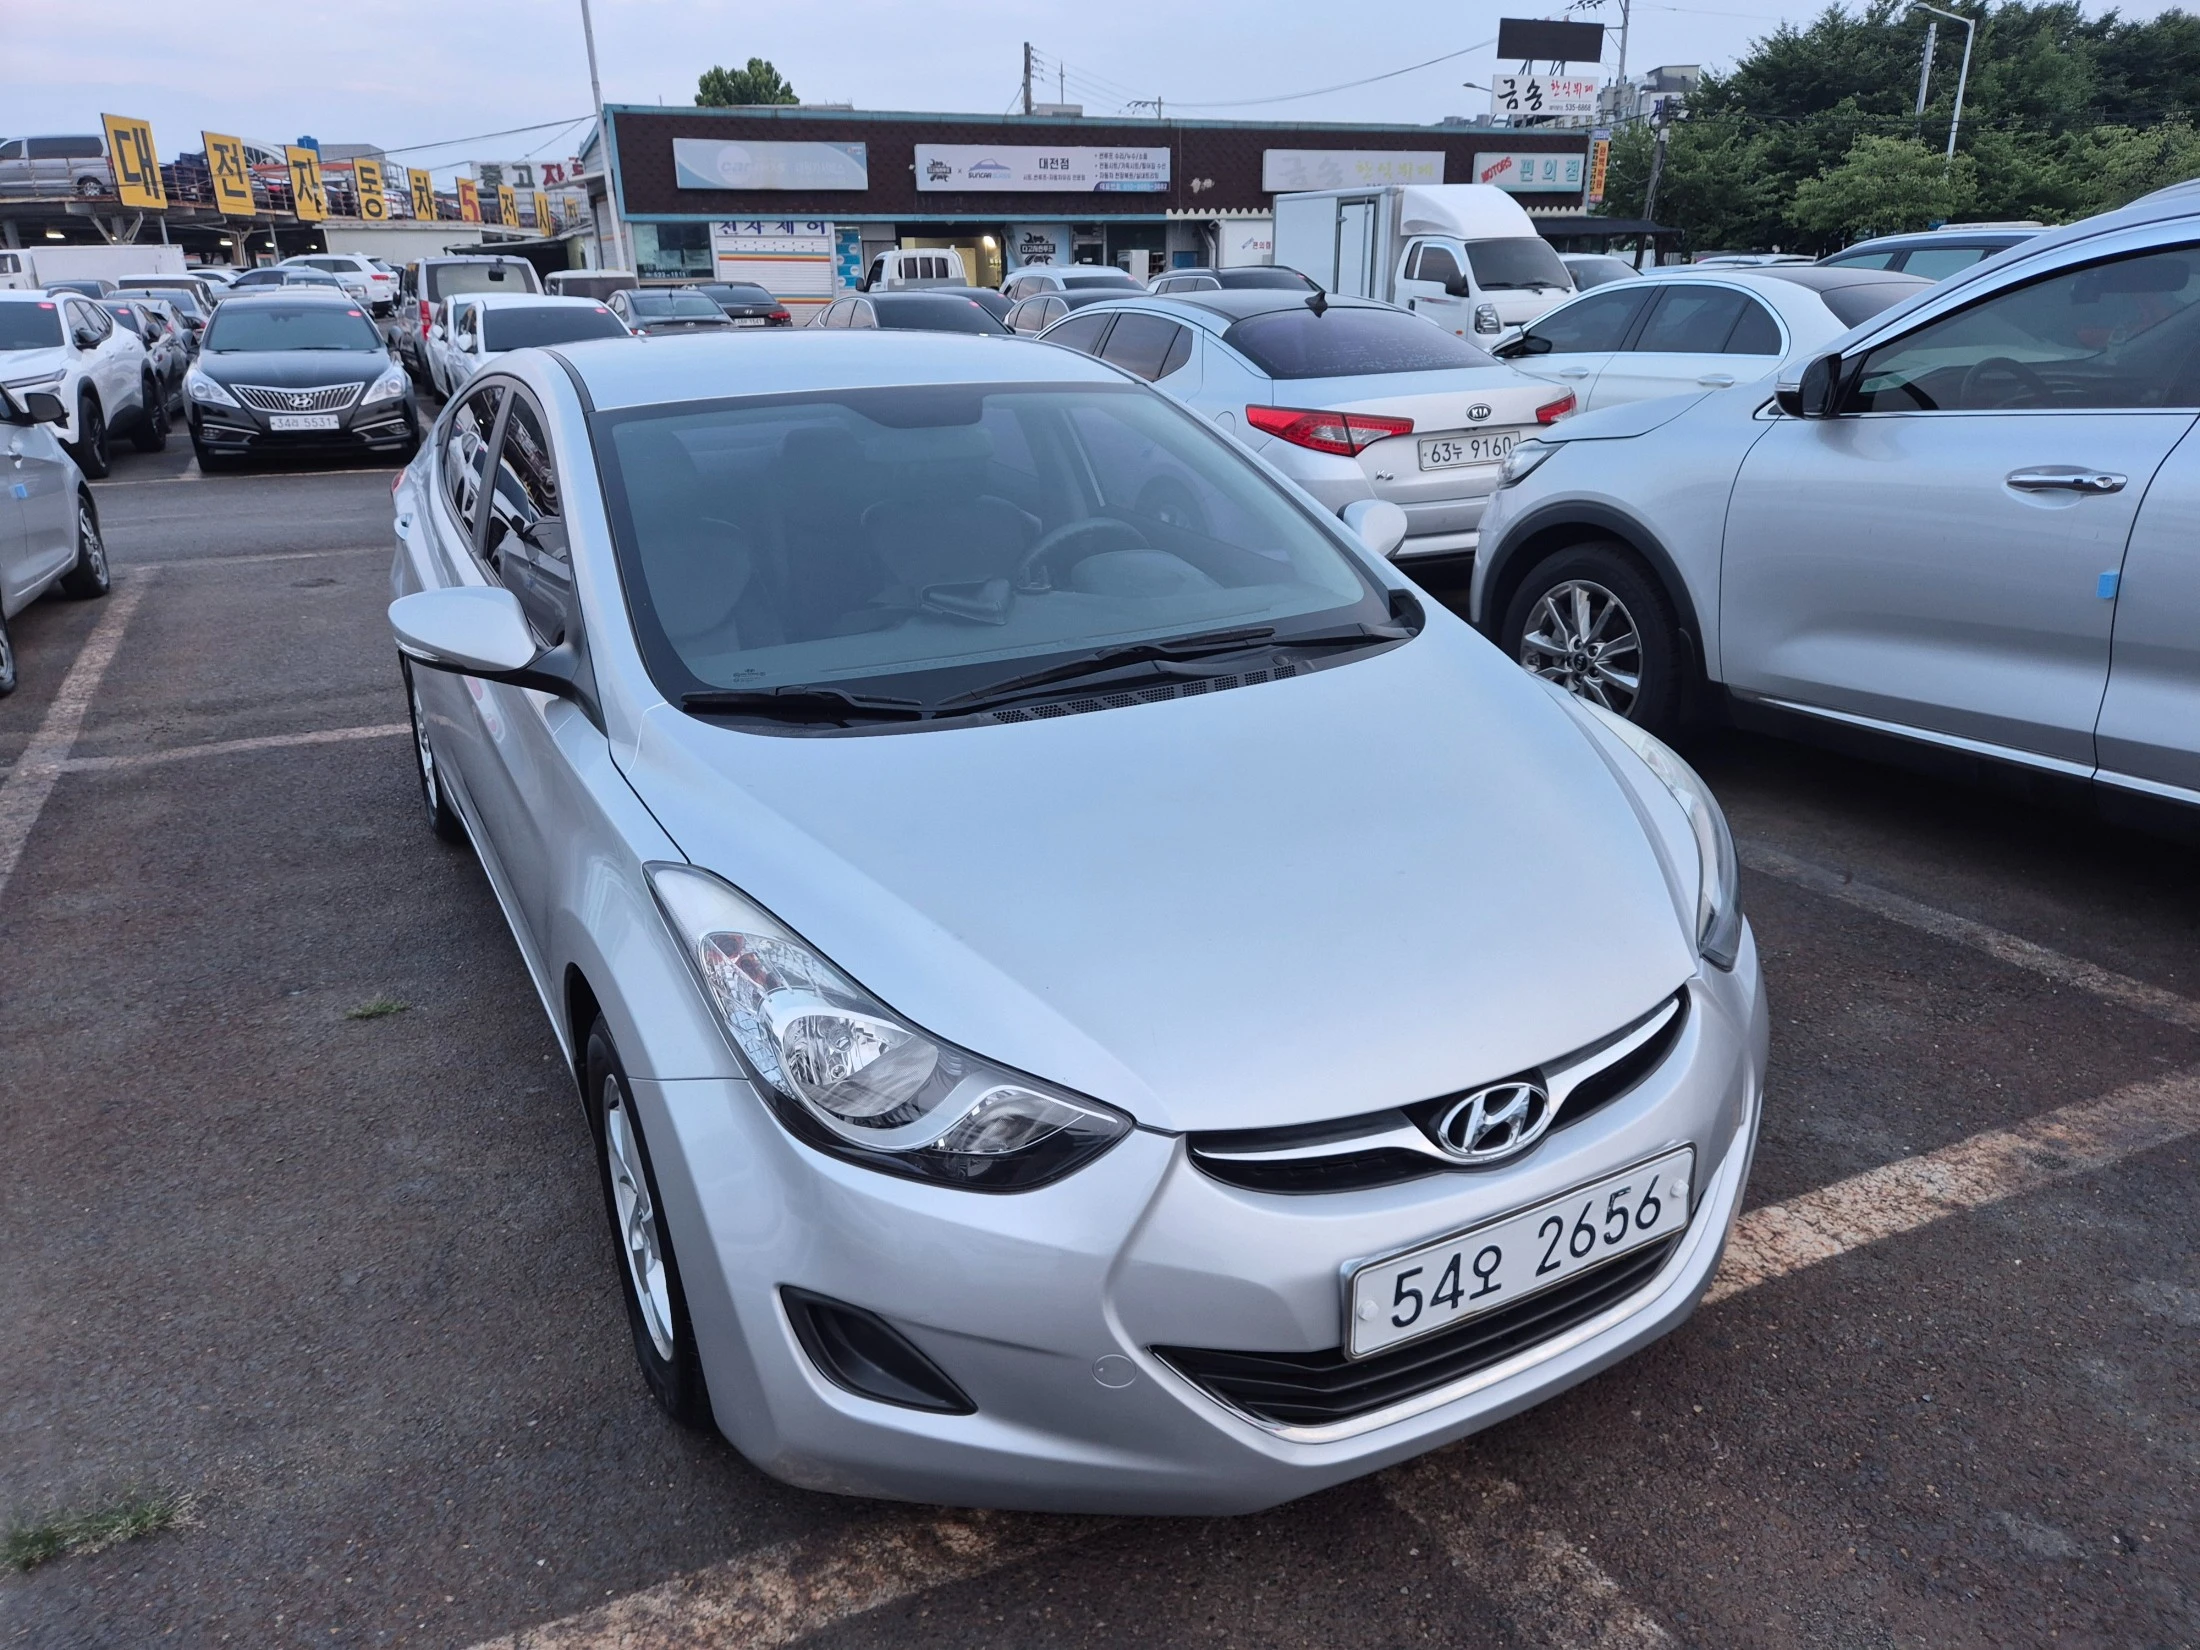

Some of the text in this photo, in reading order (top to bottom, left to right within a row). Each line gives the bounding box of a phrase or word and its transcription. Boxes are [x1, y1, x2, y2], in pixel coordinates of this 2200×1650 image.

[1498, 78, 1594, 112] 금송 한식뷔페
[1039, 158, 1070, 170] 대전점
[1481, 156, 1512, 183] MOTORS
[1520, 159, 1579, 182] 편의점
[304, 417, 332, 427] 5531
[1471, 408, 1489, 418] KIA
[1431, 437, 1512, 463] 63누 9160
[1391, 1174, 1662, 1328] 54오 2656
